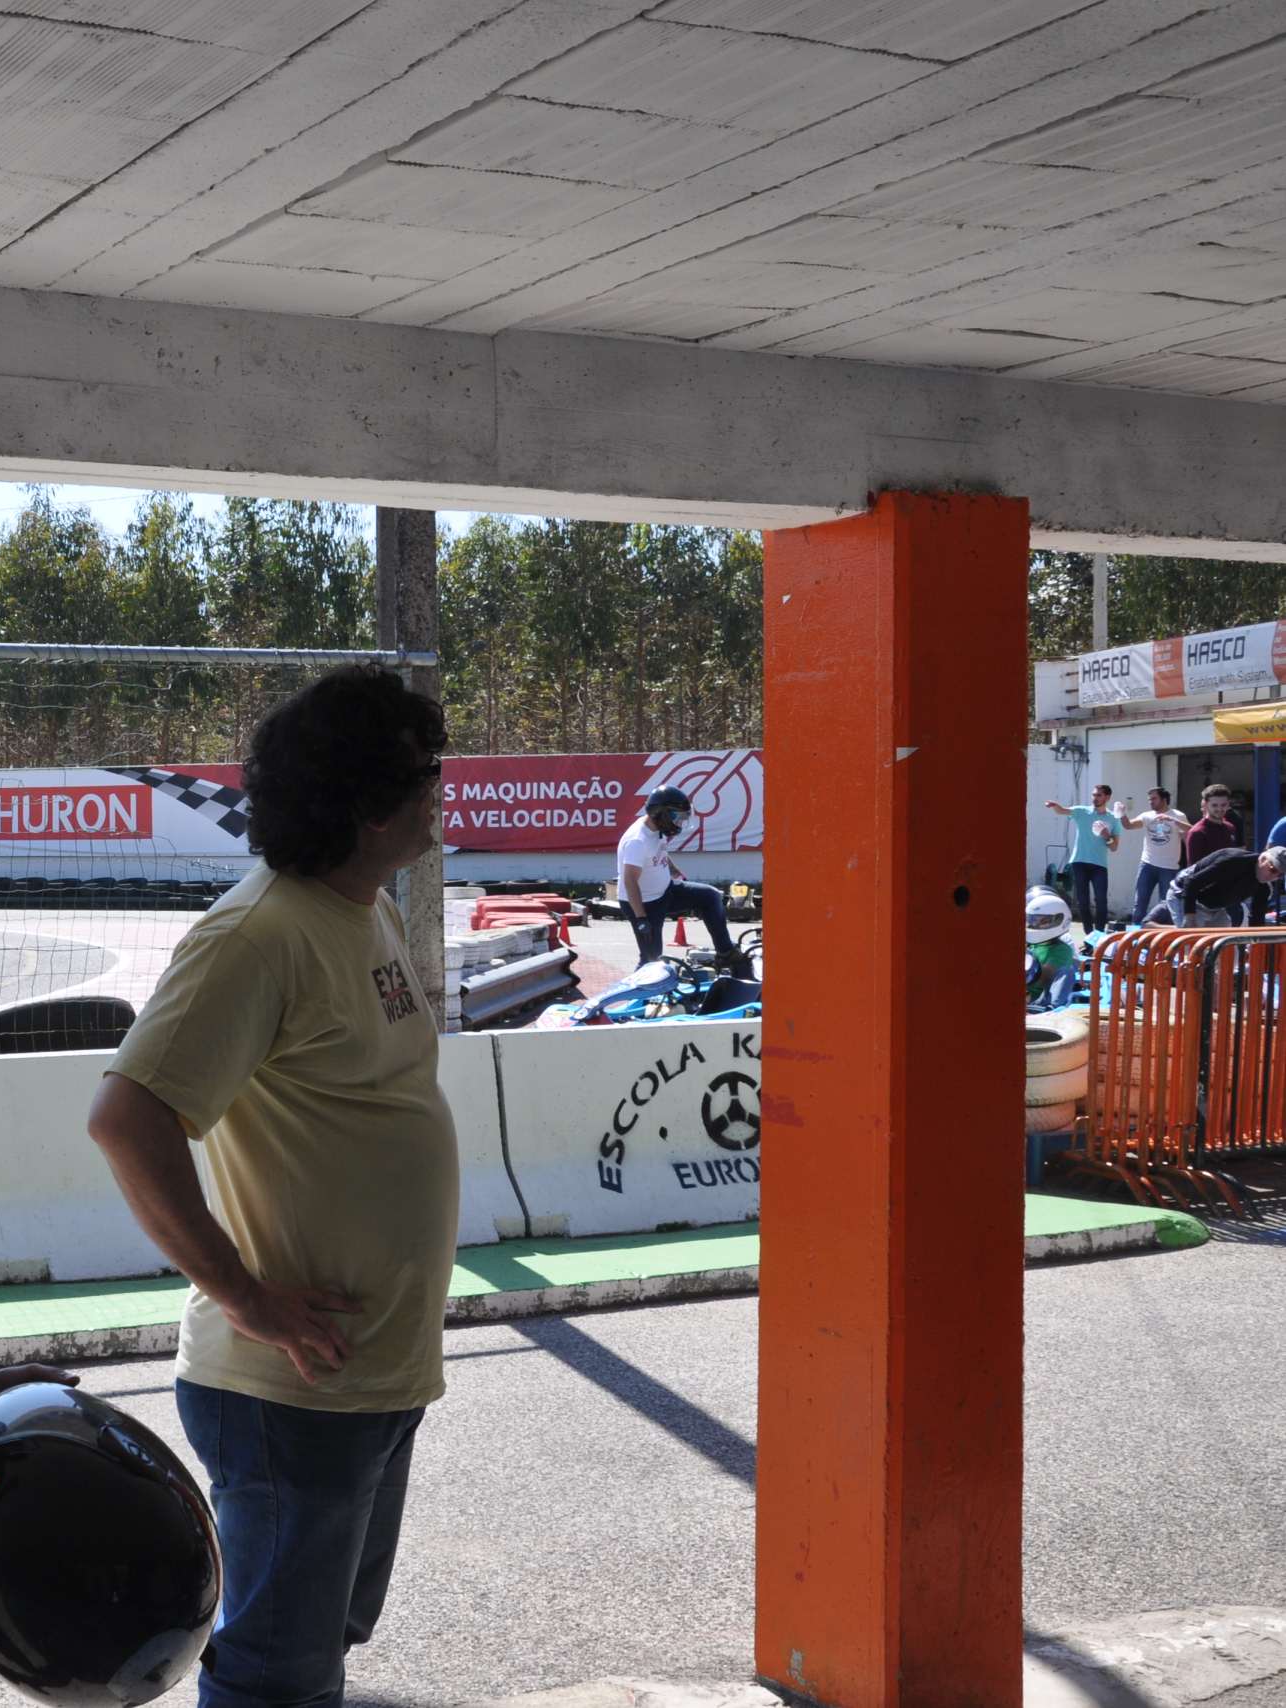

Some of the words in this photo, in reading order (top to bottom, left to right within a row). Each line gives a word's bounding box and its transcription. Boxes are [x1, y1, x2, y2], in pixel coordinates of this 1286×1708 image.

[1188, 636, 1246, 667] HASCO
[1082, 655, 1130, 683] HASCO
[462, 776, 623, 804] MAQUINAÇÃO
[470, 809, 617, 828] VELOCIDADE
[597, 1042, 706, 1194] ESCOLA
[672, 1156, 760, 1189] EURO
